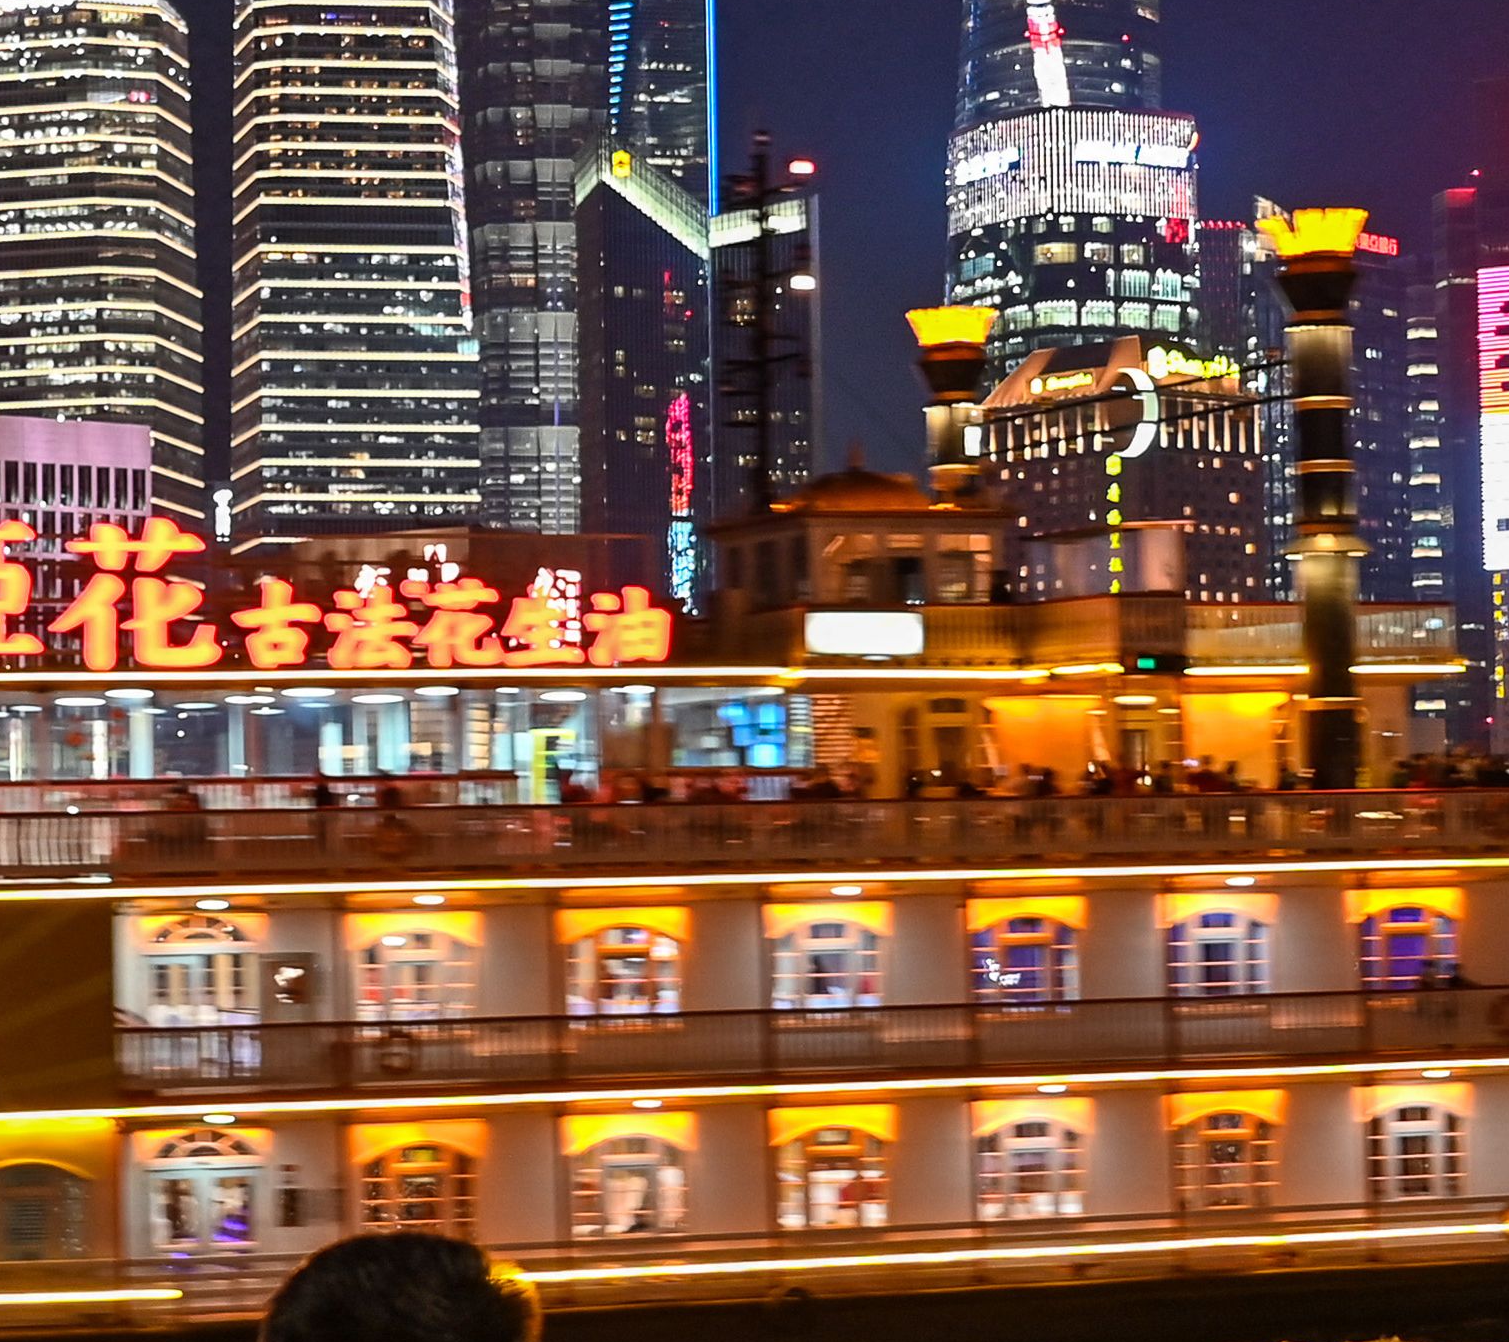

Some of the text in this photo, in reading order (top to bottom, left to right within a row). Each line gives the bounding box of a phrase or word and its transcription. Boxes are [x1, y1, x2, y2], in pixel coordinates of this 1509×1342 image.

[230, 578, 671, 669] 古法花生油
